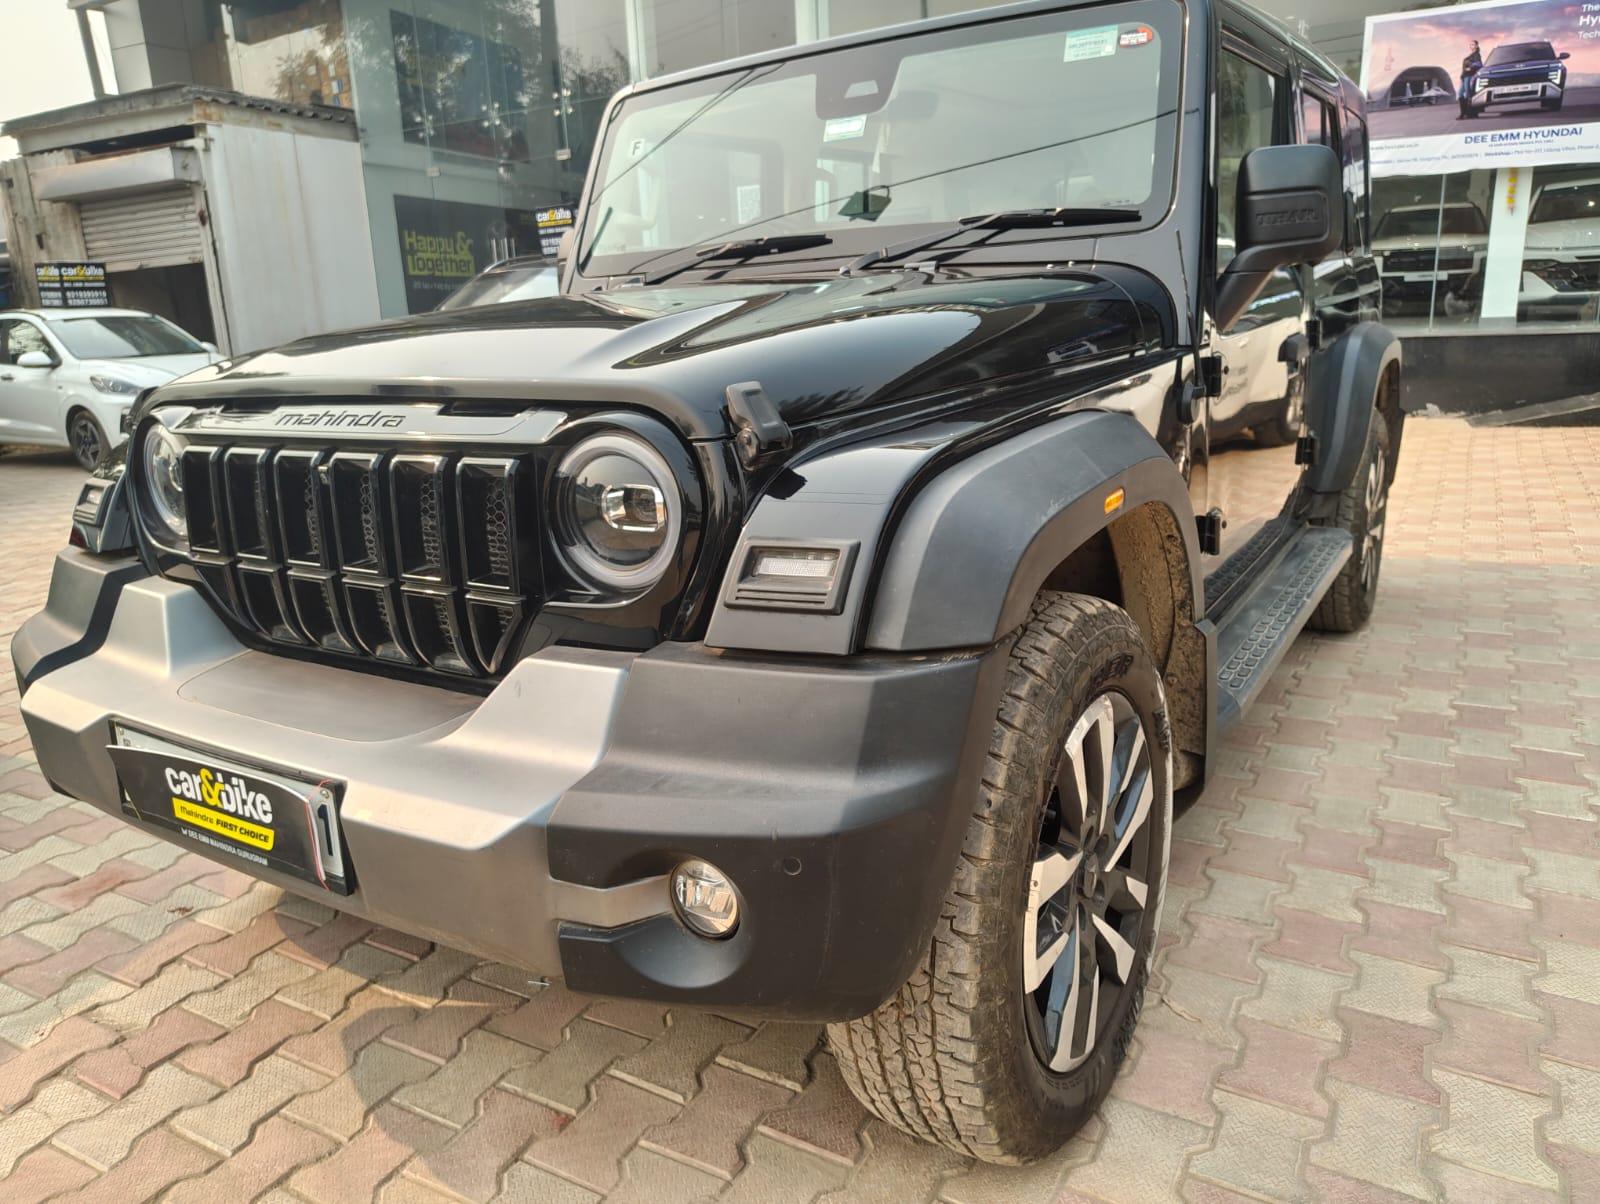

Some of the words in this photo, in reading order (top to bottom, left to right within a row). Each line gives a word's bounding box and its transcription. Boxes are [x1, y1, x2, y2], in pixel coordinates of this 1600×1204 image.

[1579, 15, 1600, 27] Hy
[1464, 135, 1488, 145] DEE
[1491, 132, 1521, 143] EMM
[1523, 127, 1583, 141] HYUNDAI
[404, 230, 455, 255] Happy
[408, 253, 475, 276] Together
[275, 410, 406, 428] mahindra
[165, 767, 273, 824] car&bike
[215, 818, 239, 833] FIRST
[239, 827, 270, 843] CHOICE
